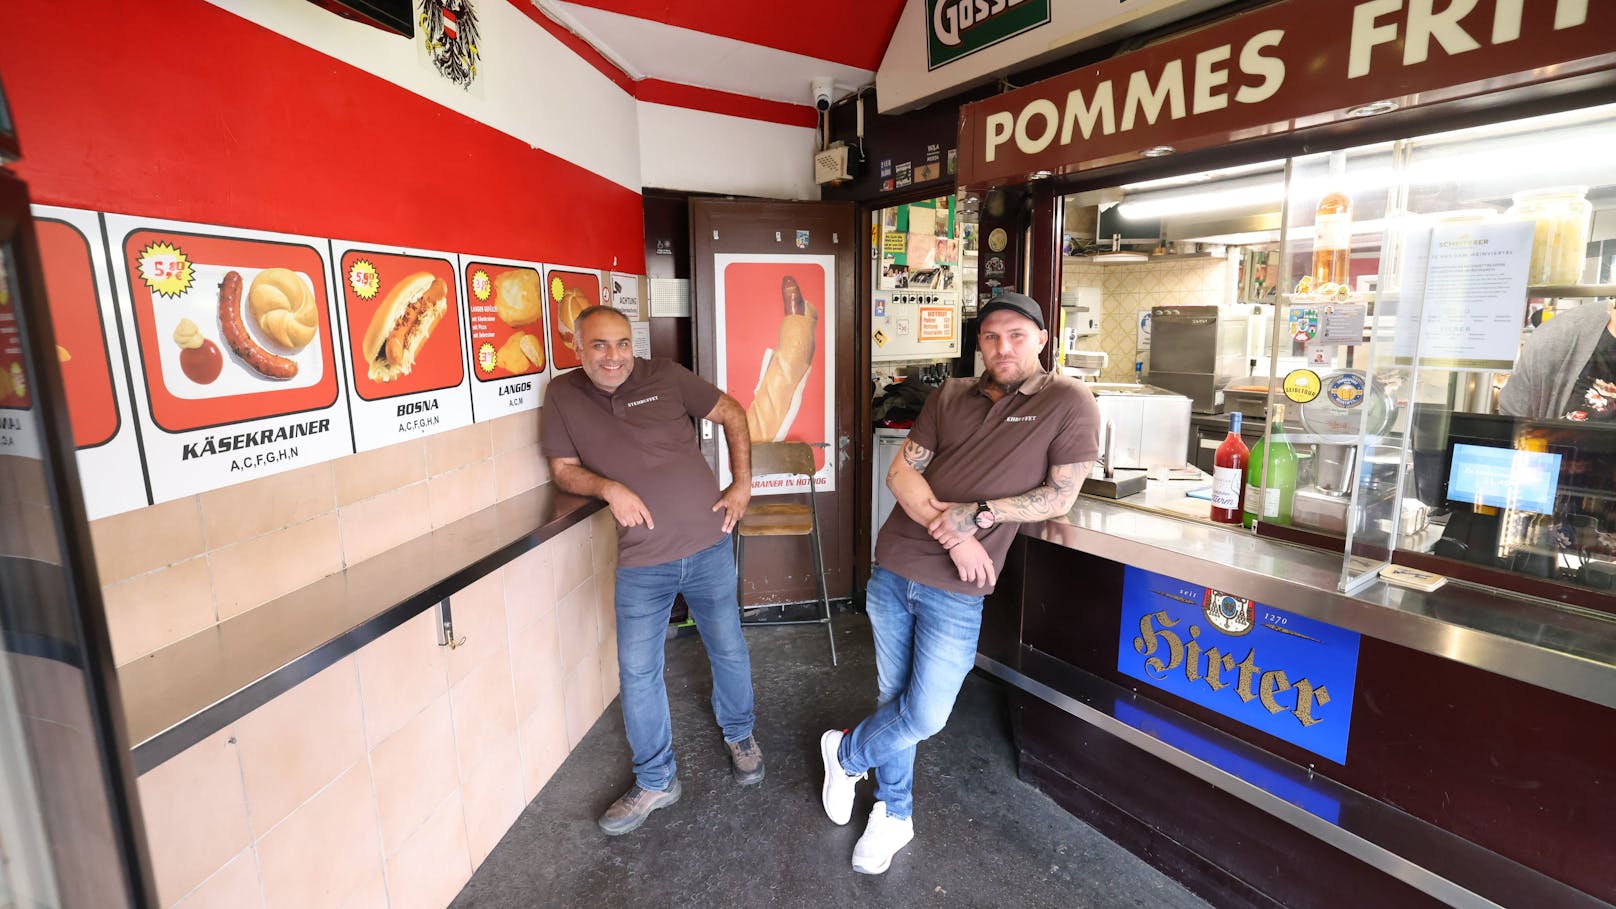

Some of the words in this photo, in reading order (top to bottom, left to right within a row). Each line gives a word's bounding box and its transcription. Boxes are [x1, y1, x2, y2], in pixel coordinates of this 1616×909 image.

[985, 29, 1286, 163] POMMES
[498, 381, 532, 396] LANGOS
[396, 398, 439, 417] BOSNA
[398, 415, 440, 432] A,C,F,G,H,N
[182, 418, 330, 461] KÄSEKRAINER
[230, 447, 299, 472] A,C,F,G,H,N
[786, 479, 794, 487] IN
[1179, 588, 1198, 598] seit
[1264, 612, 1288, 625] 1270
[1133, 609, 1332, 727] Hirter
